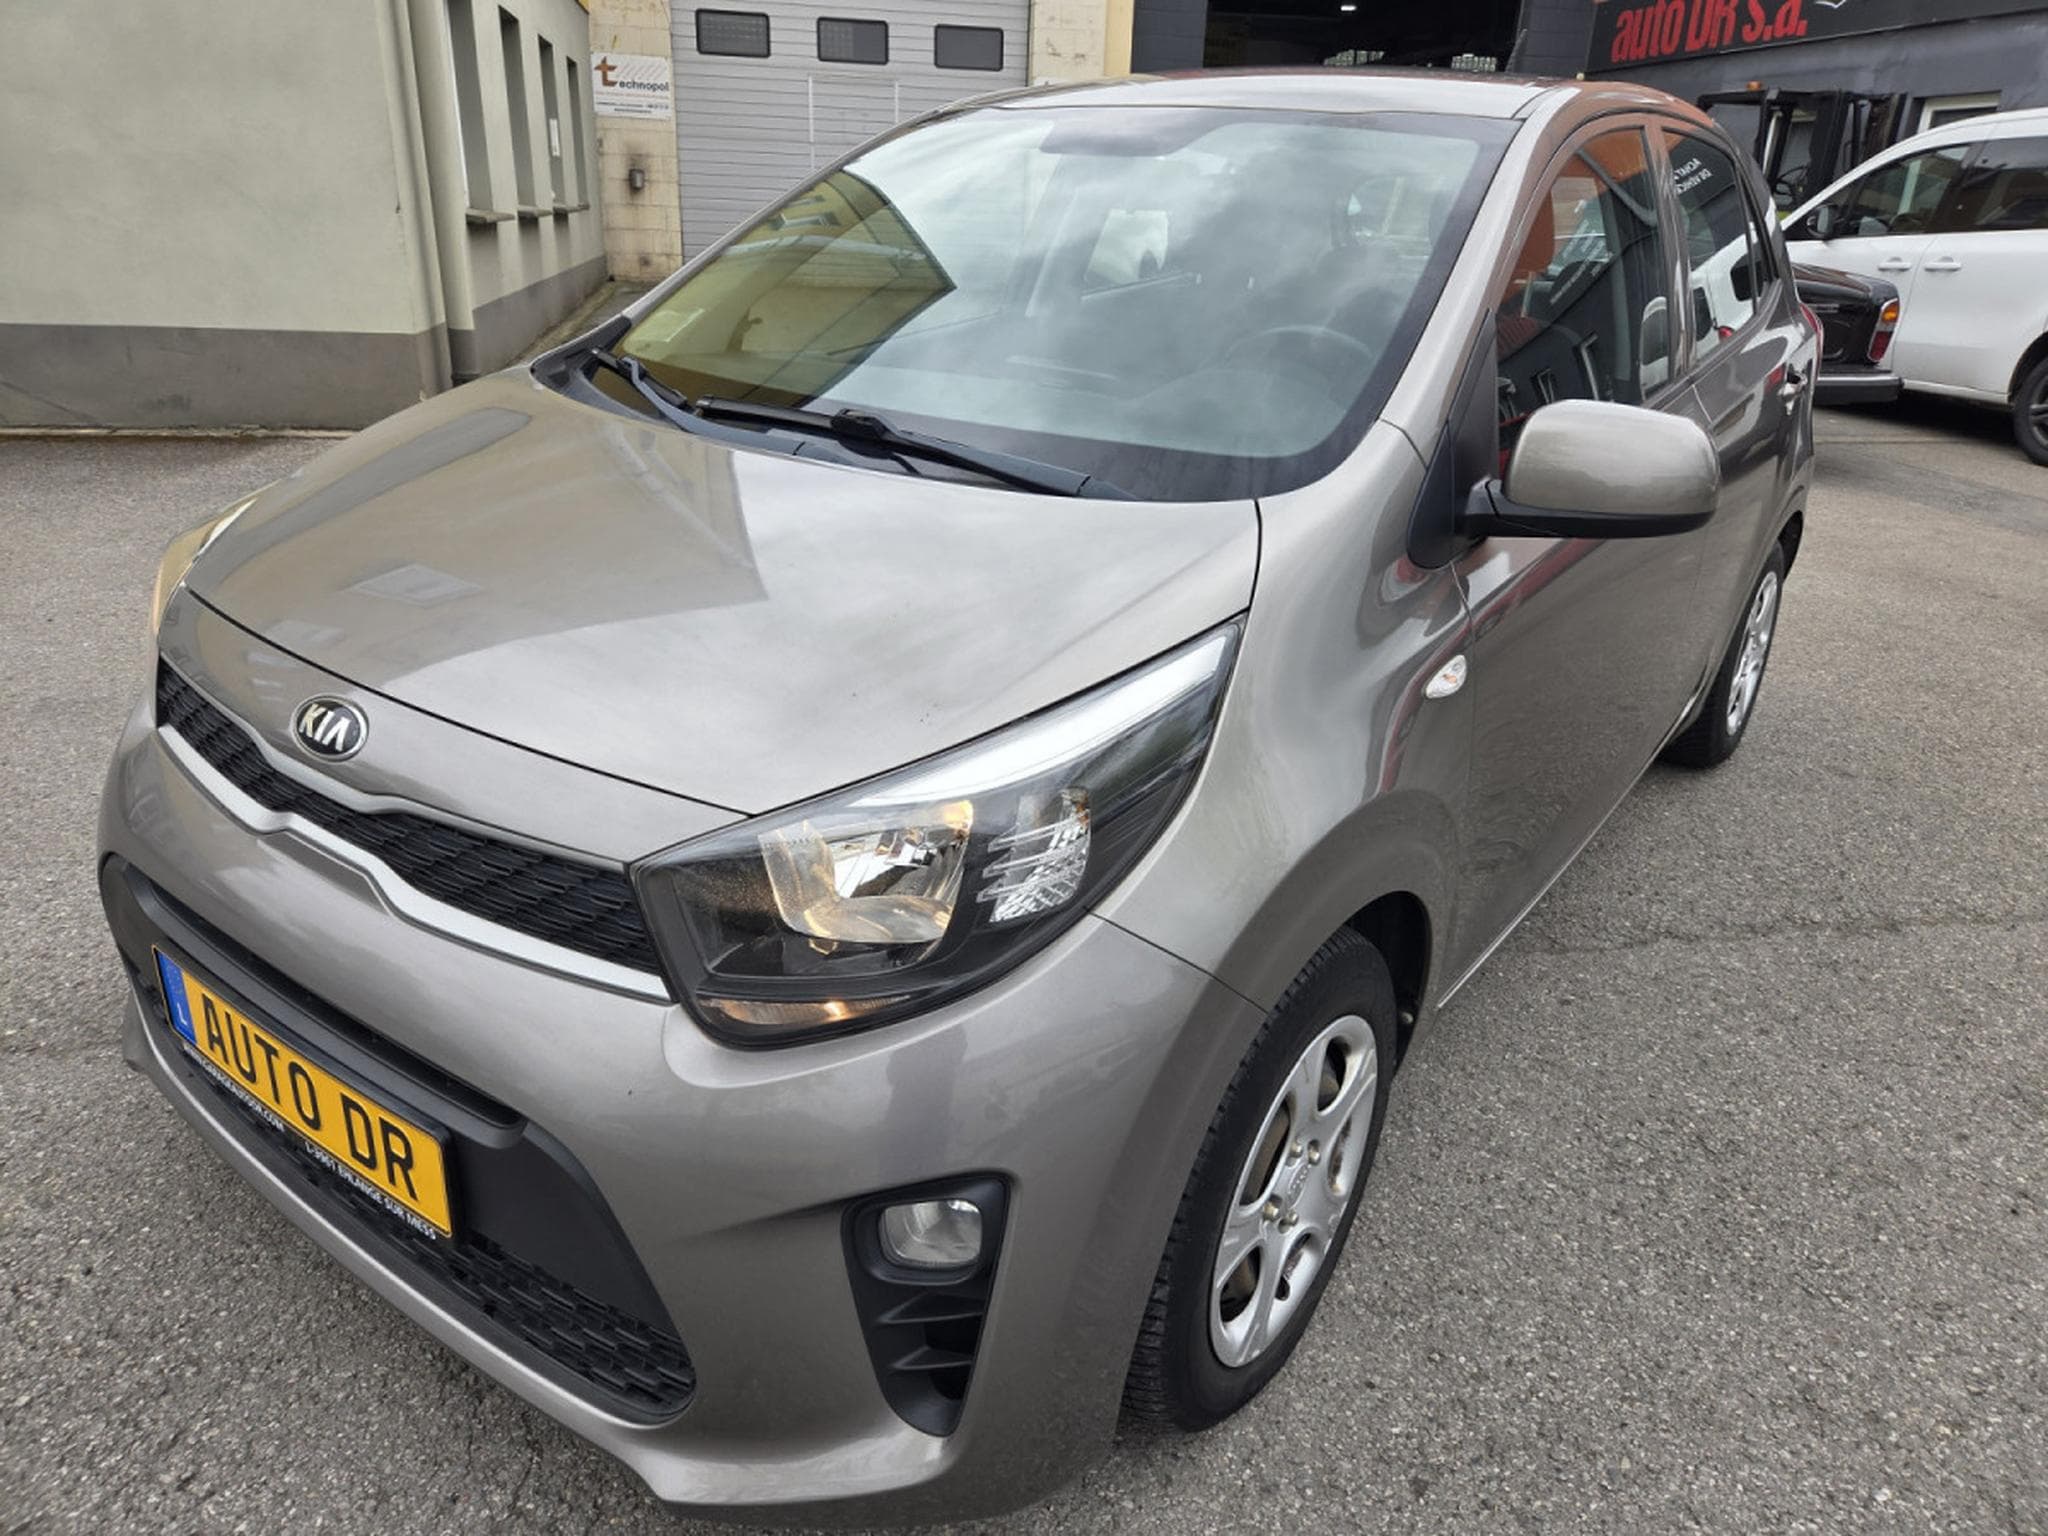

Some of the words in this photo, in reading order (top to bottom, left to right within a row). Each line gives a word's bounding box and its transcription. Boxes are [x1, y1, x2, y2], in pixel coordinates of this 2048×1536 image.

[1612, 0, 1684, 62] auto
[594, 56, 669, 92] technopol
[299, 703, 351, 752] KIA
[176, 1002, 188, 1026] L
[202, 993, 321, 1131] AUTO
[340, 1092, 418, 1202] DR
